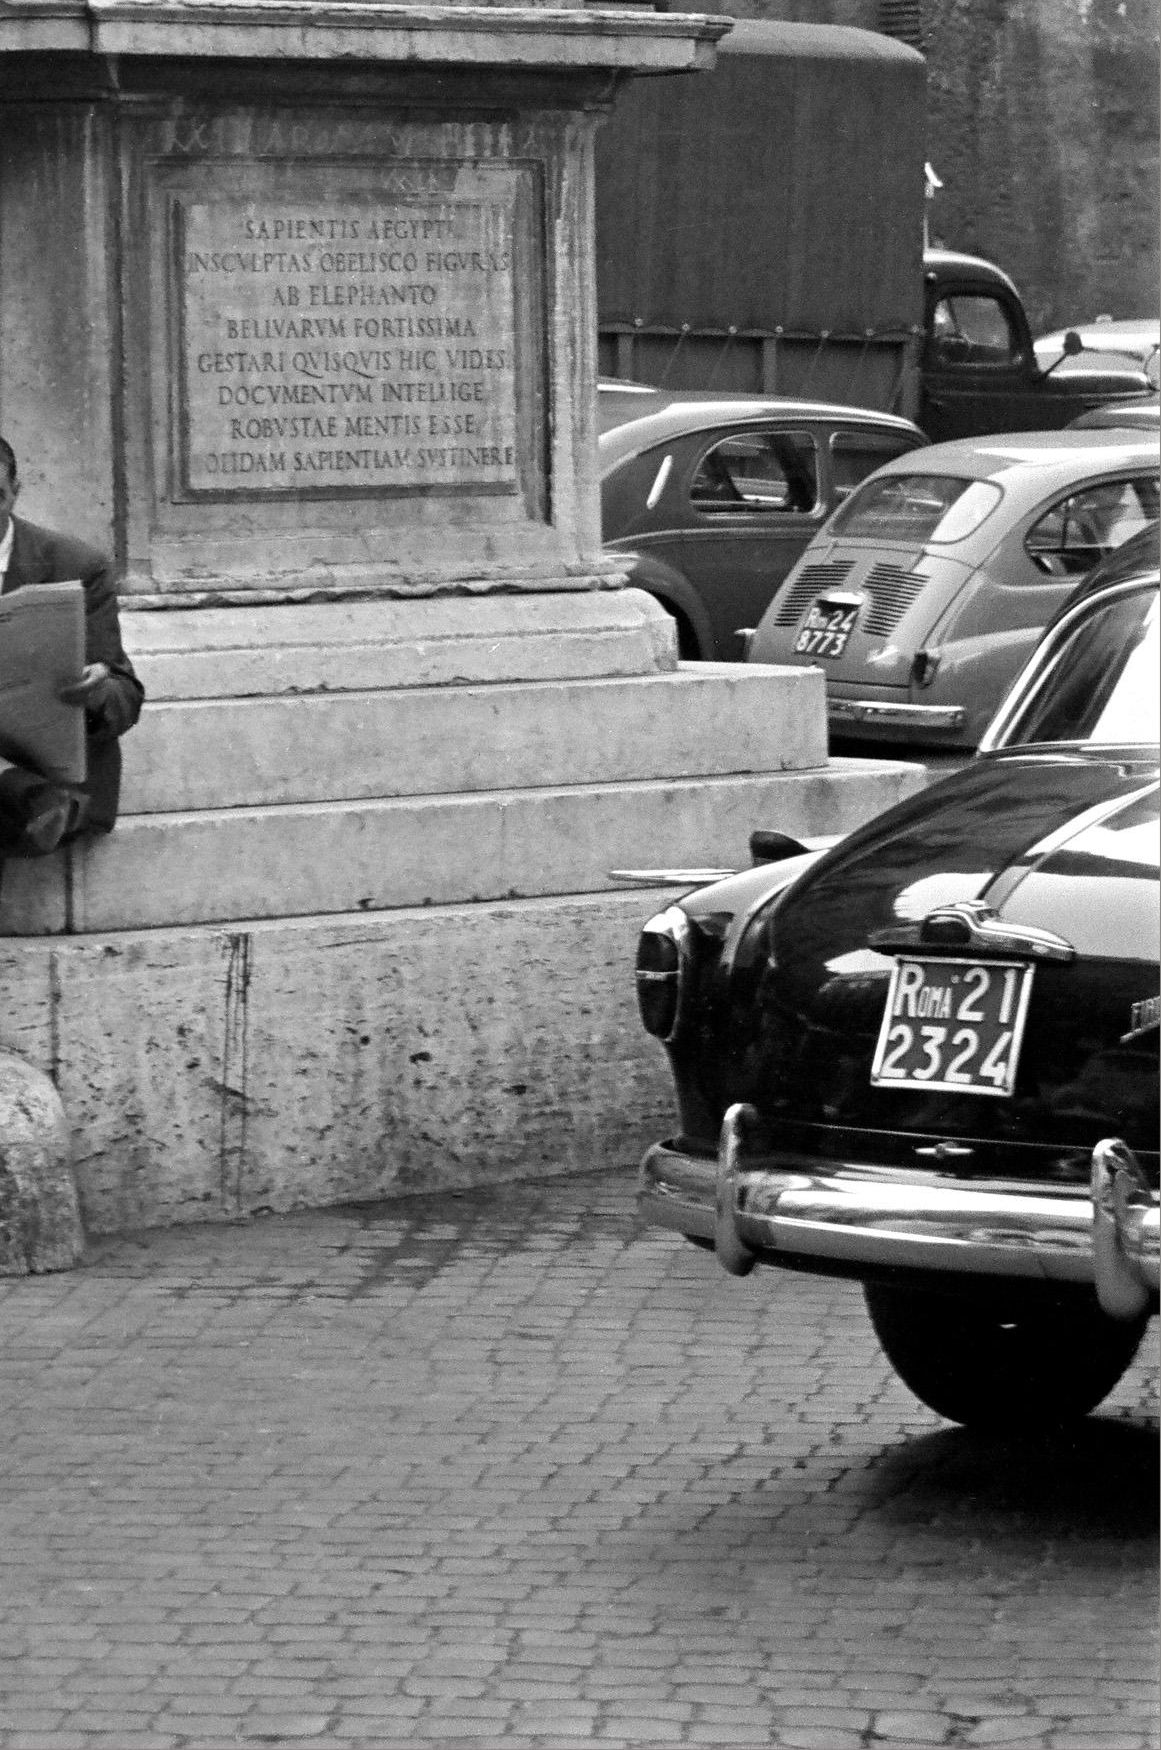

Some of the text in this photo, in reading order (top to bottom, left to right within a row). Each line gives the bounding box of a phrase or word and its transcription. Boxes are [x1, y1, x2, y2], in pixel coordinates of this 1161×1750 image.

[245, 220, 359, 239] SAPIENTIS
[320, 253, 417, 272] OBELISCO
[426, 252, 511, 271] FIGVRAS
[273, 285, 436, 305] AB ELEPHANTO
[354, 318, 476, 337] FORTISSIMA
[198, 350, 505, 378] GESTARI QVISQVIS HIC VIDES
[218, 384, 373, 404] DOCVMENTVM
[231, 414, 474, 439] ROBVSTAE MENTIS ESSE
[294, 449, 409, 471] SAPIENTIAM
[826, 610, 858, 631] 24
[796, 630, 847, 655] 8773
[957, 967, 1017, 1024] 21
[881, 1024, 1013, 1087] 2324
